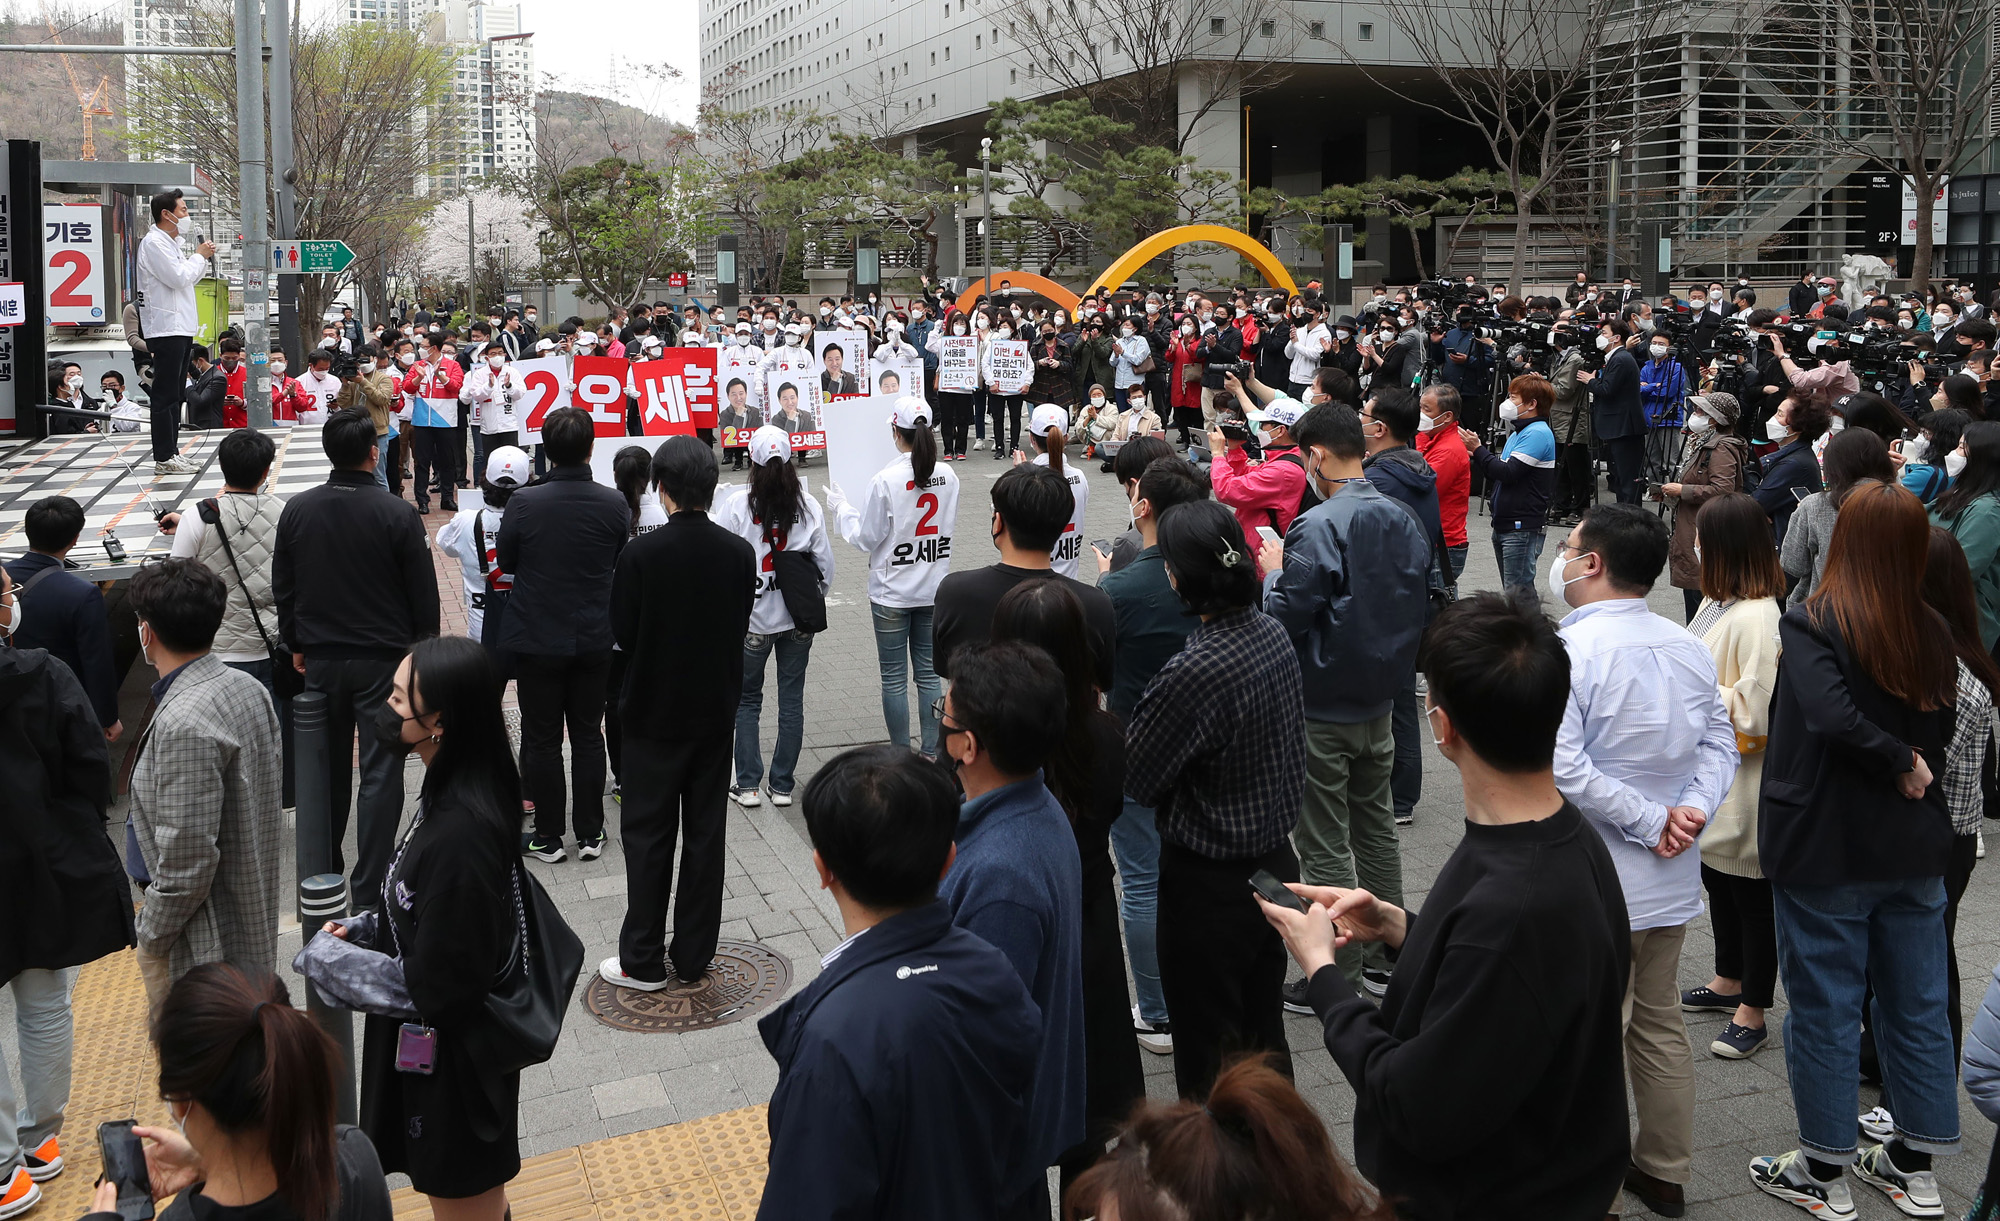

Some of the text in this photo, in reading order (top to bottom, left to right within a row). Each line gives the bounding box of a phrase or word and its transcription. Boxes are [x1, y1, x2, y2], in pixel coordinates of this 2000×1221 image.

[1959, 190, 1979, 199] juice
[46, 222, 93, 244] 기호
[1879, 232, 1890, 242] 2F
[49, 250, 93, 307] 2
[944, 349, 966, 357] 서울을
[994, 347, 1010, 357] 이번
[944, 359, 975, 367] 바꾸는 힘
[993, 359, 1025, 368] 보궐선거
[993, 369, 1022, 379] 왜 하죠?
[306, 394, 318, 411] 2
[524, 370, 560, 433] 2
[578, 374, 623, 424] 오
[644, 375, 690, 424] 세
[1271, 408, 1295, 424] 오세훈
[723, 426, 739, 446] 2
[791, 433, 825, 447] 오세훈
[915, 493, 938, 536] 2
[892, 535, 951, 566] 오세훈
